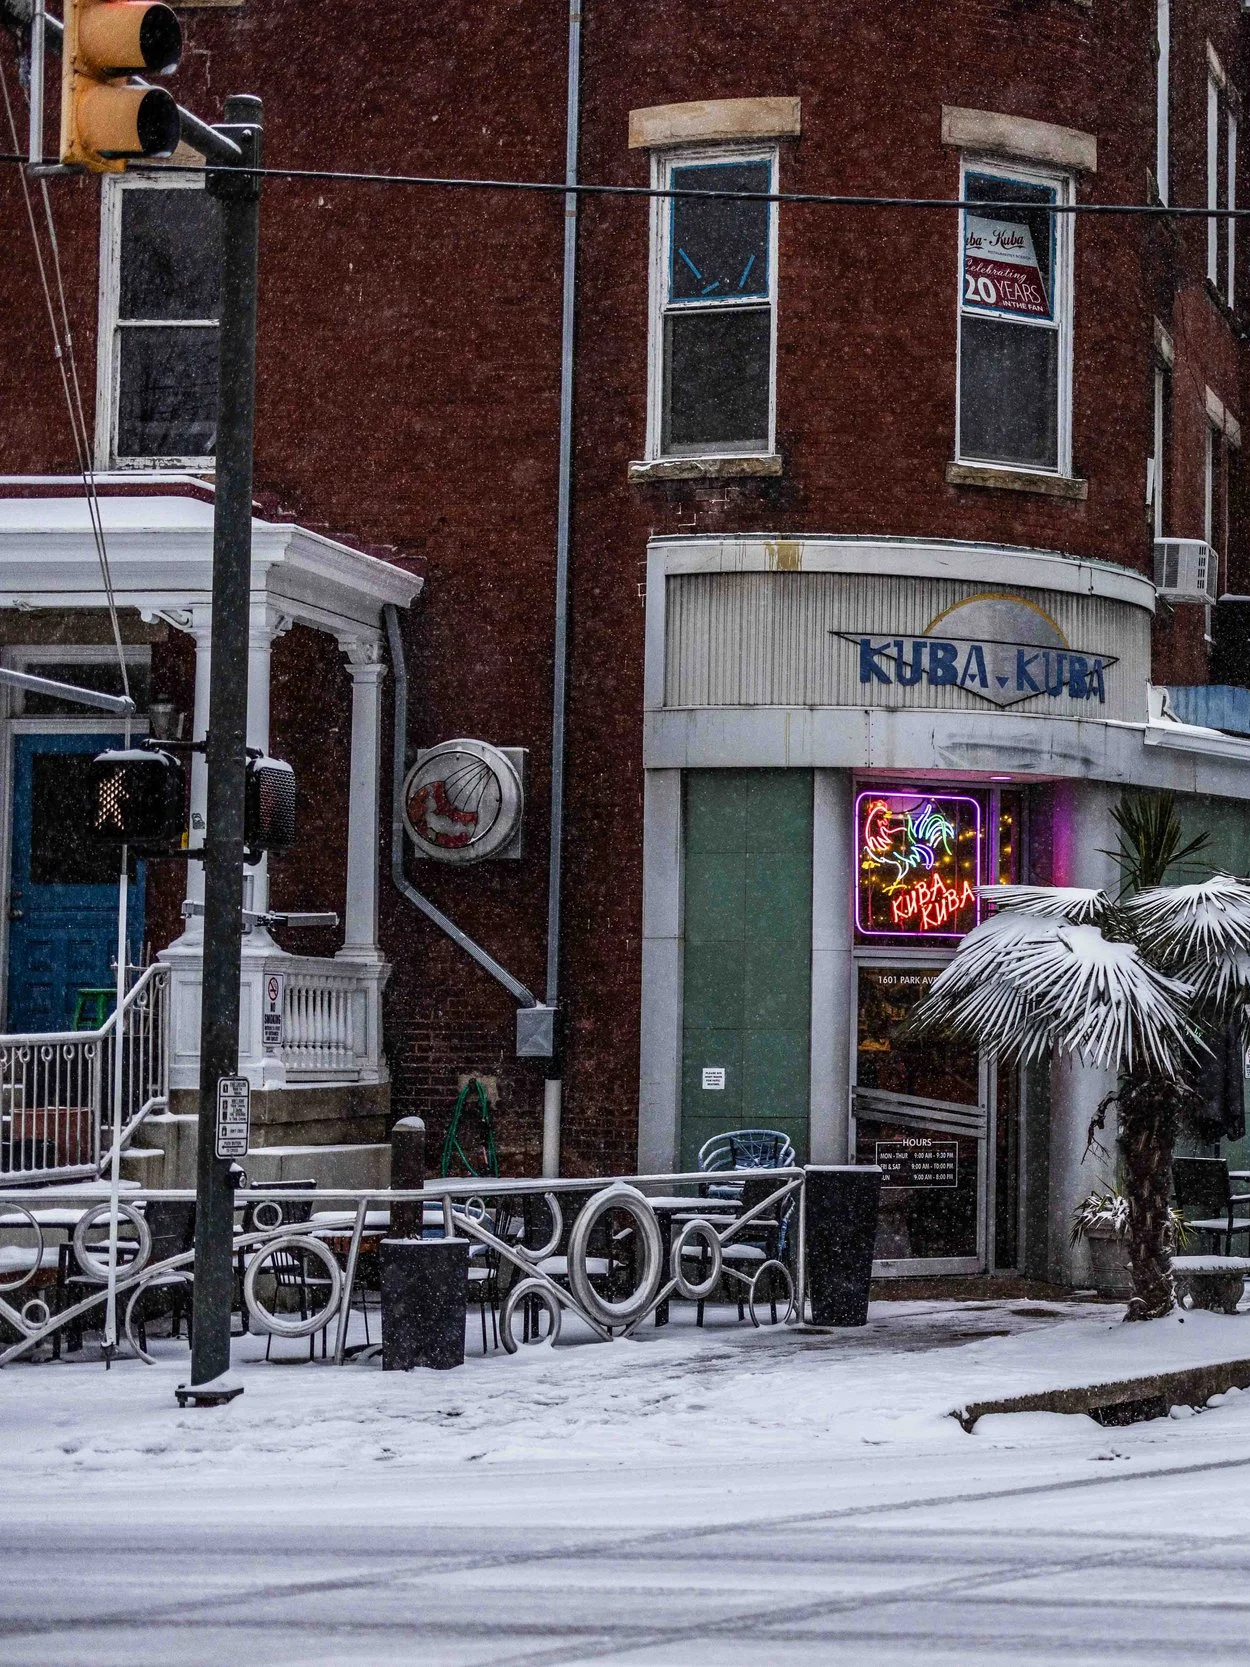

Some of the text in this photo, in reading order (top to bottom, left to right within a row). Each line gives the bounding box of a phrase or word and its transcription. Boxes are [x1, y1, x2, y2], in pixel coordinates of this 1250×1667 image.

[965, 273, 1041, 304] 20 YEARS
[1010, 301, 1028, 310] THE
[1028, 303, 1044, 312] FAN
[860, 638, 1105, 703] KUBA KUBA
[892, 873, 947, 923] KUBA
[922, 880, 976, 930] KUBA
[878, 975, 897, 984] 1601
[900, 975, 921, 984] PARK
[902, 1138, 932, 1147] HOURS
